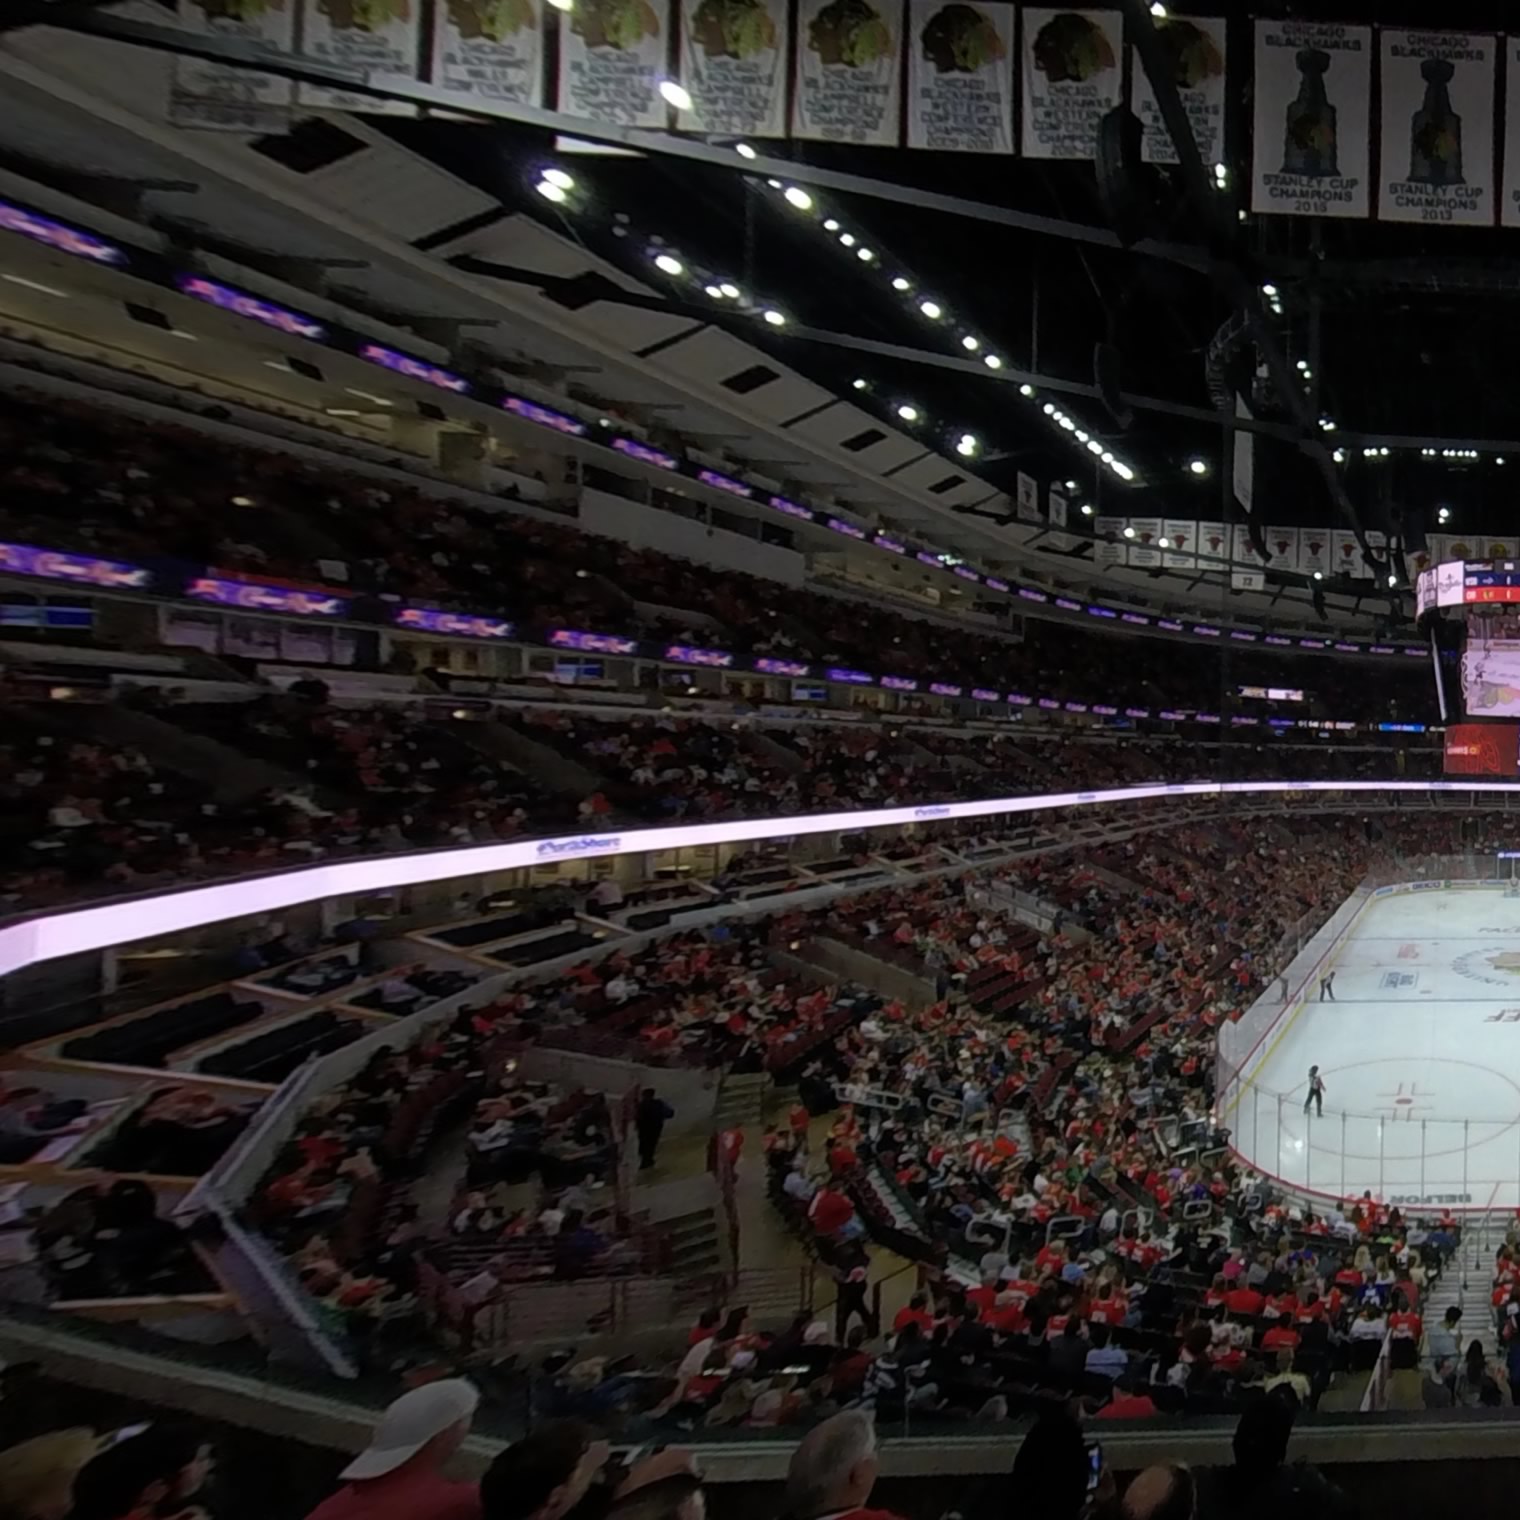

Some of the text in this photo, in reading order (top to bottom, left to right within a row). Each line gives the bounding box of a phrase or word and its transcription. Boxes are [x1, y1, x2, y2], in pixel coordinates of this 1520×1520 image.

[1282, 23, 1345, 37] CHICAGO
[1265, 35, 1361, 50] BLACKHAWKS
[1407, 33, 1470, 48] CHICAGO
[1391, 45, 1485, 61] BLACKHAWKS
[1263, 174, 1359, 189] STANLEY CUP
[1269, 187, 1353, 201] CHAMPIONS
[1388, 183, 1483, 198] STANLEY CUP
[1395, 196, 1478, 211] CHAMPIONS
